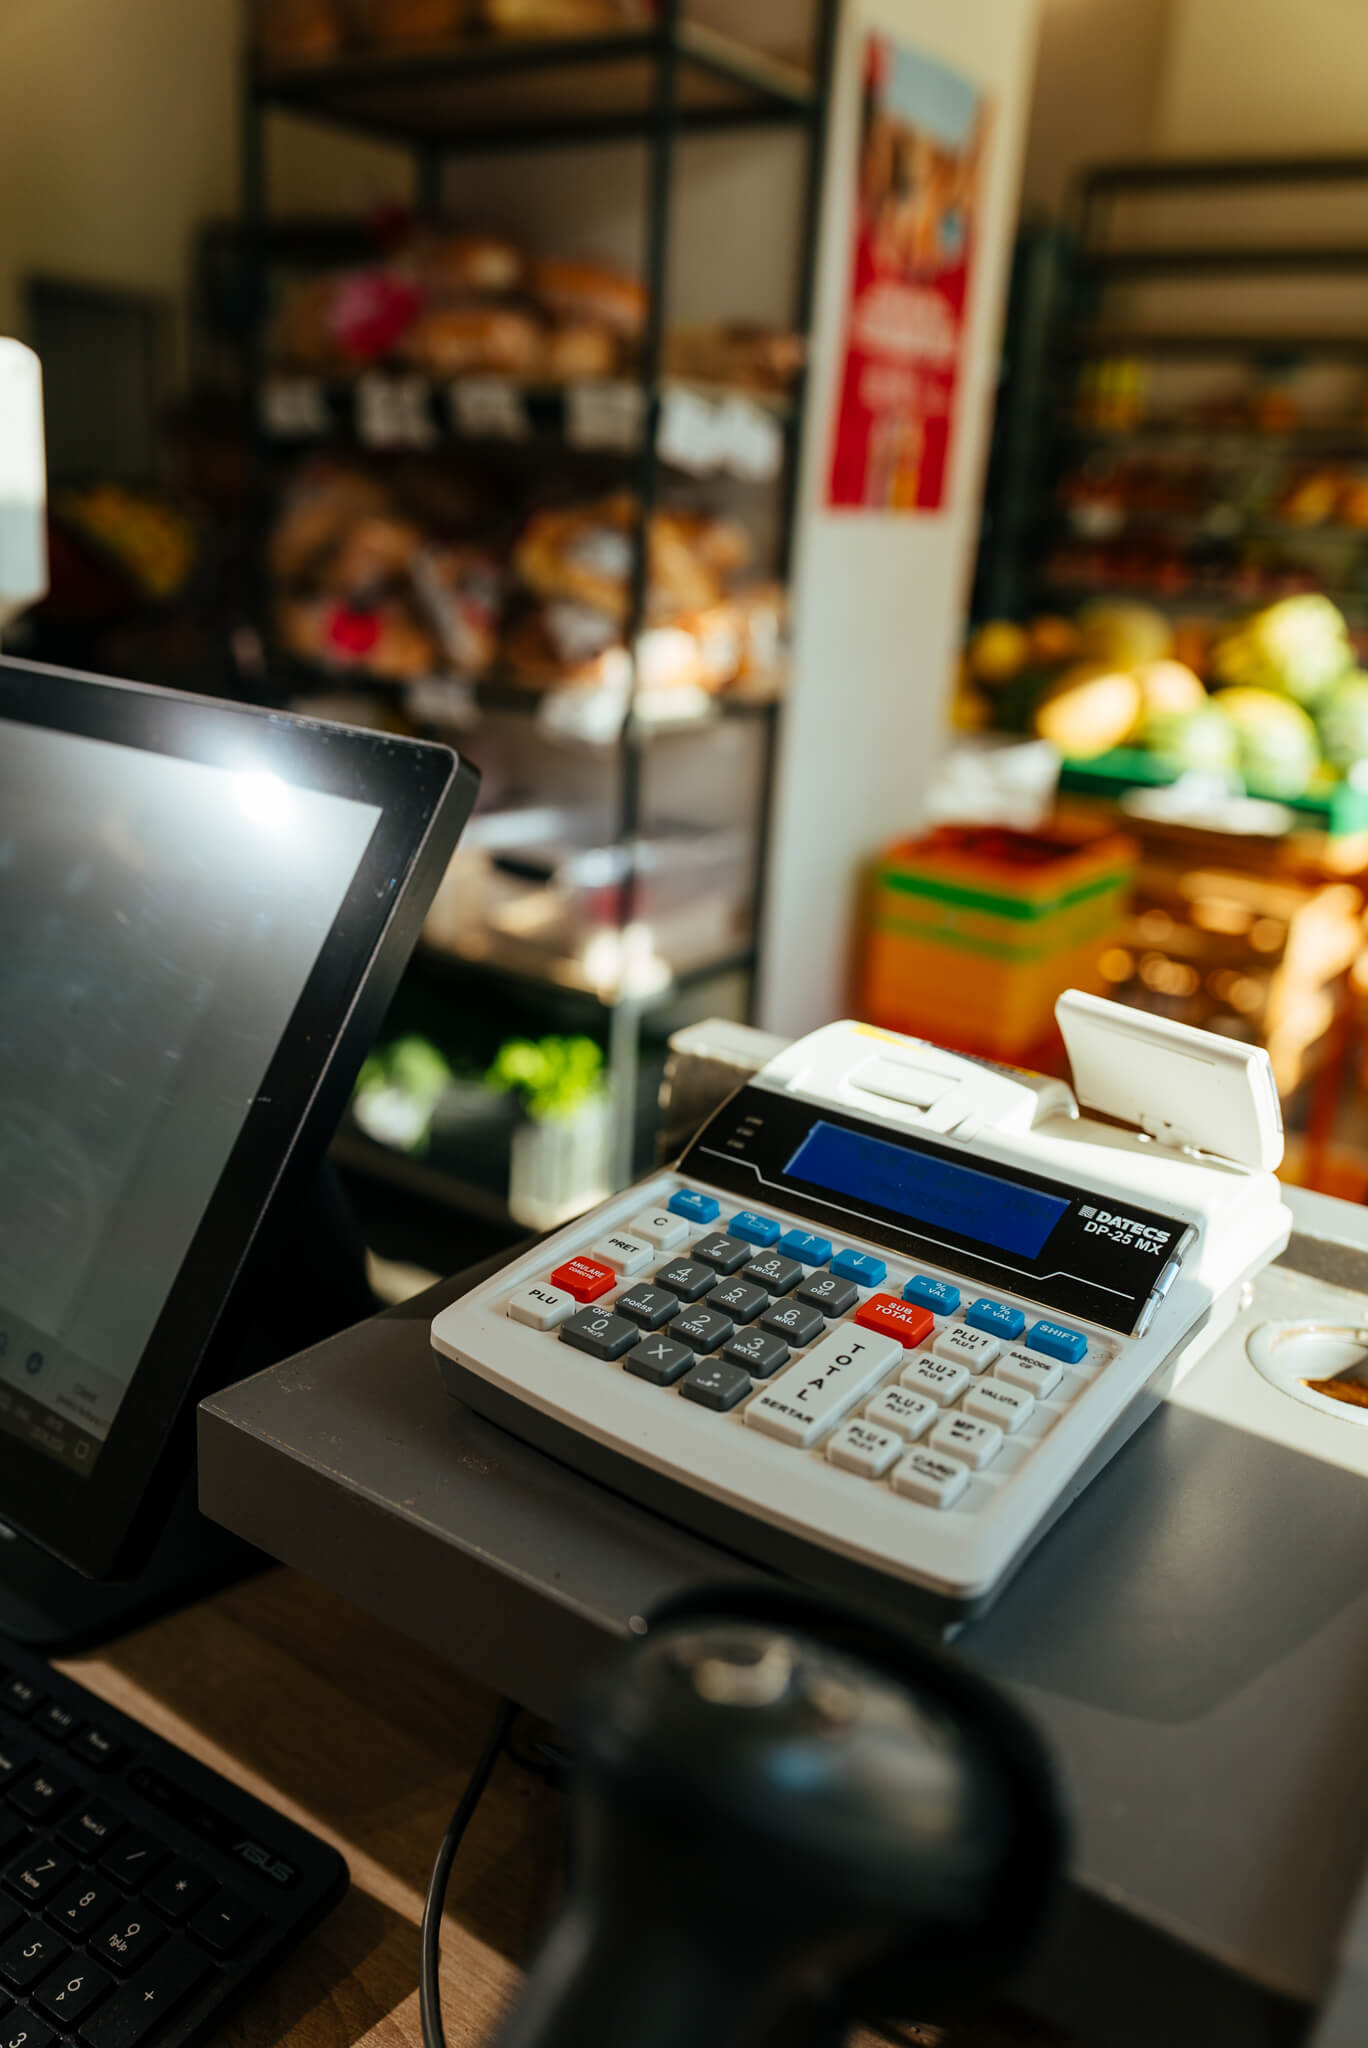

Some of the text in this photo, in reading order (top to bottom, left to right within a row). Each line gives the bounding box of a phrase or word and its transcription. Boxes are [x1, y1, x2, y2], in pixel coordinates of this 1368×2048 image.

[653, 1217, 669, 1226] C
[1095, 1210, 1171, 1243] DATECS
[608, 1238, 639, 1254] PRET
[713, 1239, 731, 1251] 7
[1083, 1221, 1164, 1256] DP-25 MX
[569, 1260, 605, 1278] ANULARE
[764, 1259, 781, 1270] 8
[677, 1267, 693, 1278] 4
[728, 1287, 748, 1299] 5
[810, 1287, 830, 1297] DEF
[819, 1280, 836, 1292] 9
[528, 1288, 558, 1305] PLU
[642, 1293, 656, 1304] 1
[720, 1294, 737, 1304] JKL
[592, 1307, 614, 1319] OFF
[783, 1309, 801, 1321] 6
[875, 1304, 913, 1324] TOTAL
[887, 1302, 913, 1314] SUB
[591, 1319, 609, 1331] 0
[691, 1315, 711, 1328] 2
[773, 1314, 795, 1327] MNO
[952, 1328, 989, 1347] PLU 1
[1039, 1323, 1080, 1343] SHIFT
[747, 1337, 765, 1350] 3
[950, 1337, 968, 1347] PLU
[733, 1343, 761, 1359] WXYZ
[919, 1358, 957, 1377] PLU 2
[1009, 1351, 1053, 1371] BARCODE
[797, 1343, 866, 1402] TOTAL
[918, 1368, 936, 1380] PLU
[887, 1391, 925, 1413] PLU 3
[760, 1397, 815, 1425] SERTAR
[848, 1426, 877, 1442] PLU
[34, 1858, 56, 1872] 7
[232, 1841, 295, 1882] ASUS
[79, 1891, 96, 1907] 8
[124, 1922, 141, 1937] 9
[23, 1942, 43, 1957] 5
[108, 1933, 128, 1952] PgUp
[67, 1976, 85, 1992] 6
[8, 2032, 27, 2048] 3
